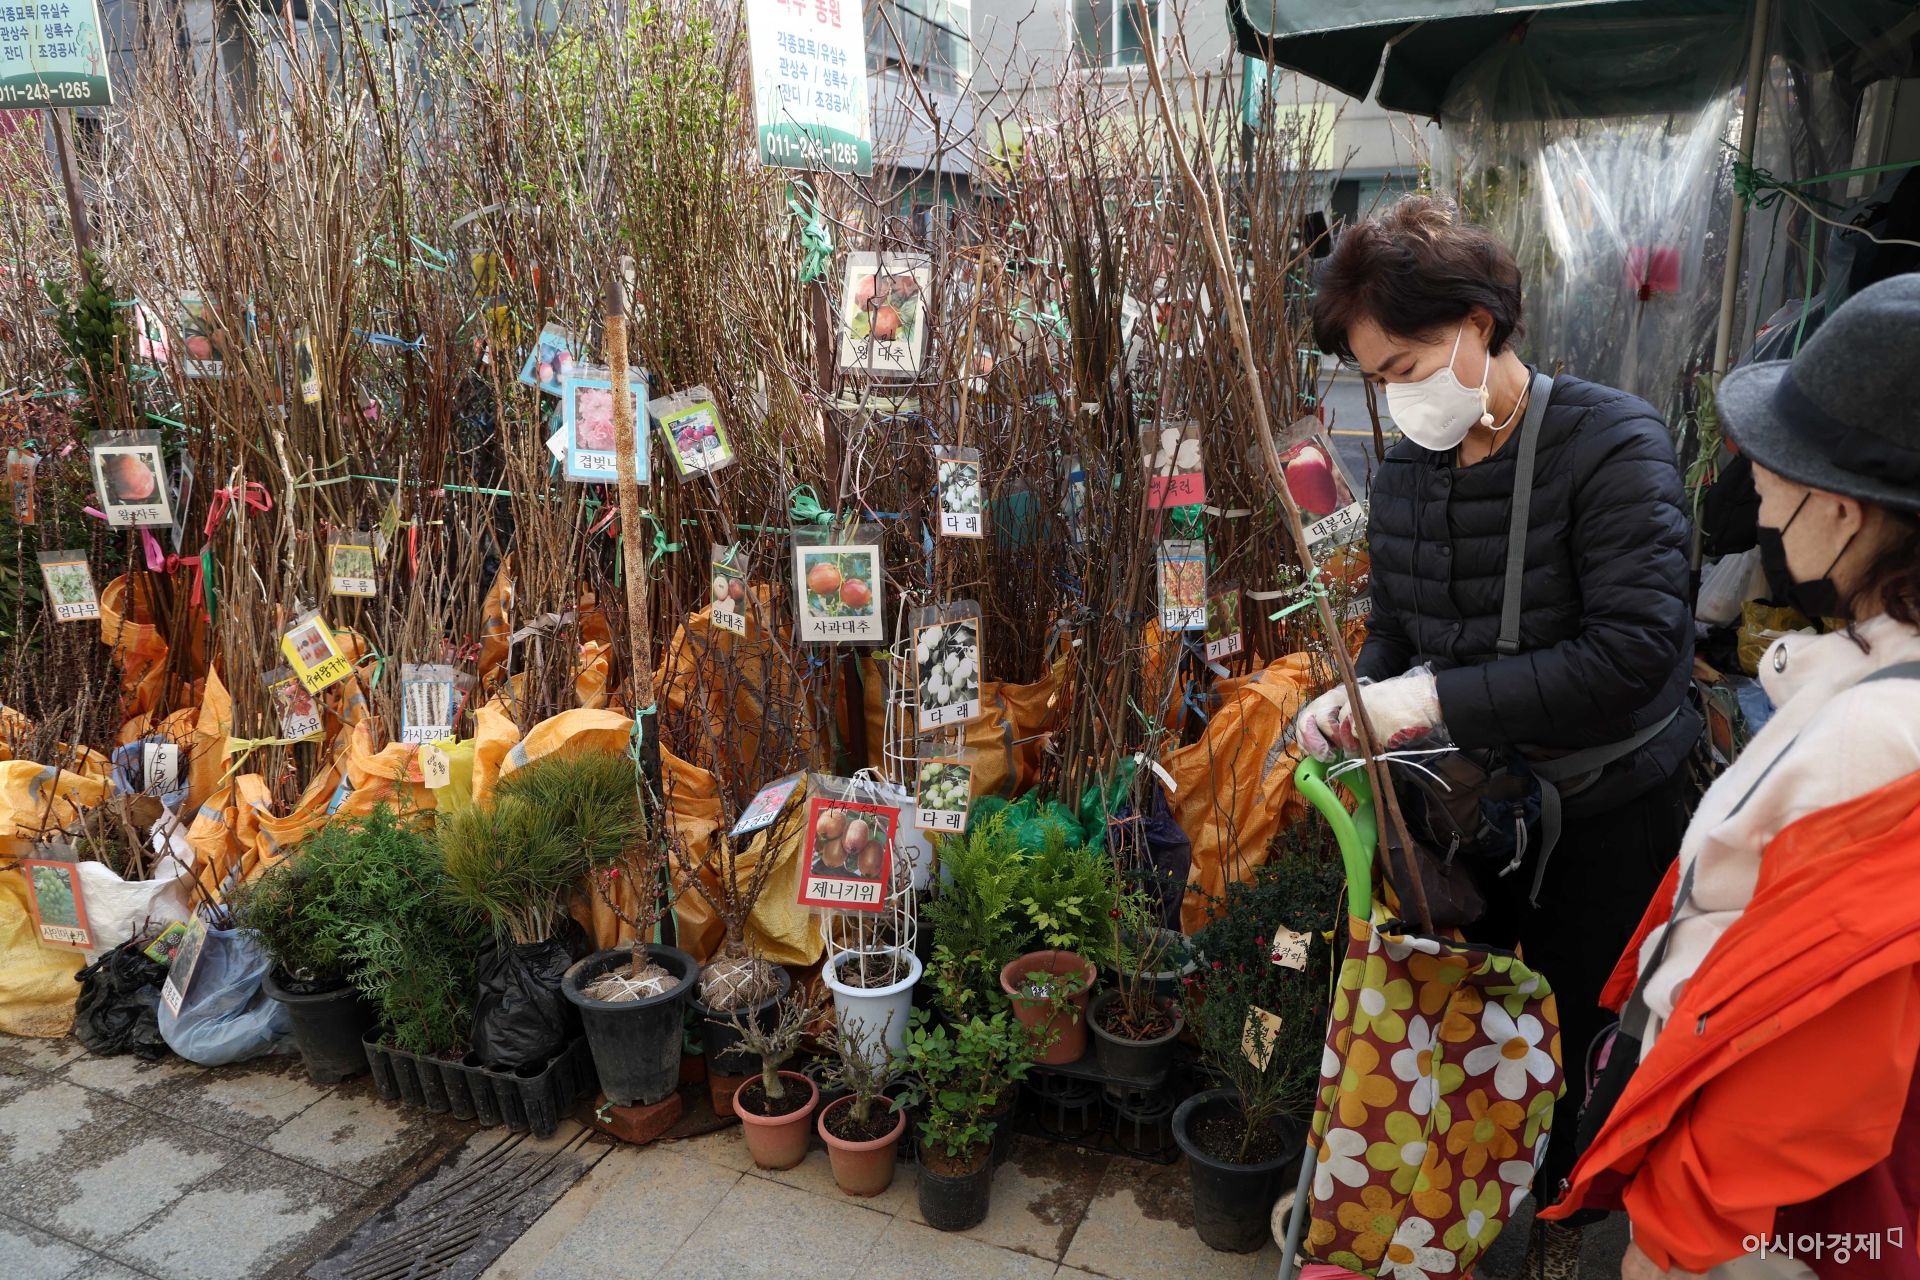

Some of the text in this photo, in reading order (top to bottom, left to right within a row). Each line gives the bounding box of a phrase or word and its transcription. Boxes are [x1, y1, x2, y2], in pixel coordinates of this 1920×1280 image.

[0, 24, 29, 41] 관상수
[44, 22, 73, 39] 상록수
[4, 45, 24, 60] 잔디
[38, 42, 77, 58] 조경공사
[779, 57, 809, 81] 관상수
[823, 68, 848, 91] 상록수
[781, 83, 801, 104] 잔디
[815, 90, 850, 115] 조경공사
[766, 132, 859, 165] 011-243-1265
[1311, 509, 1353, 536] 대봉감
[57, 603, 98, 618] 엄나무
[713, 609, 744, 631] 왕대추
[813, 620, 871, 634] 사과대추
[287, 717, 320, 740] 산수유
[812, 880, 875, 902] 제니키위
